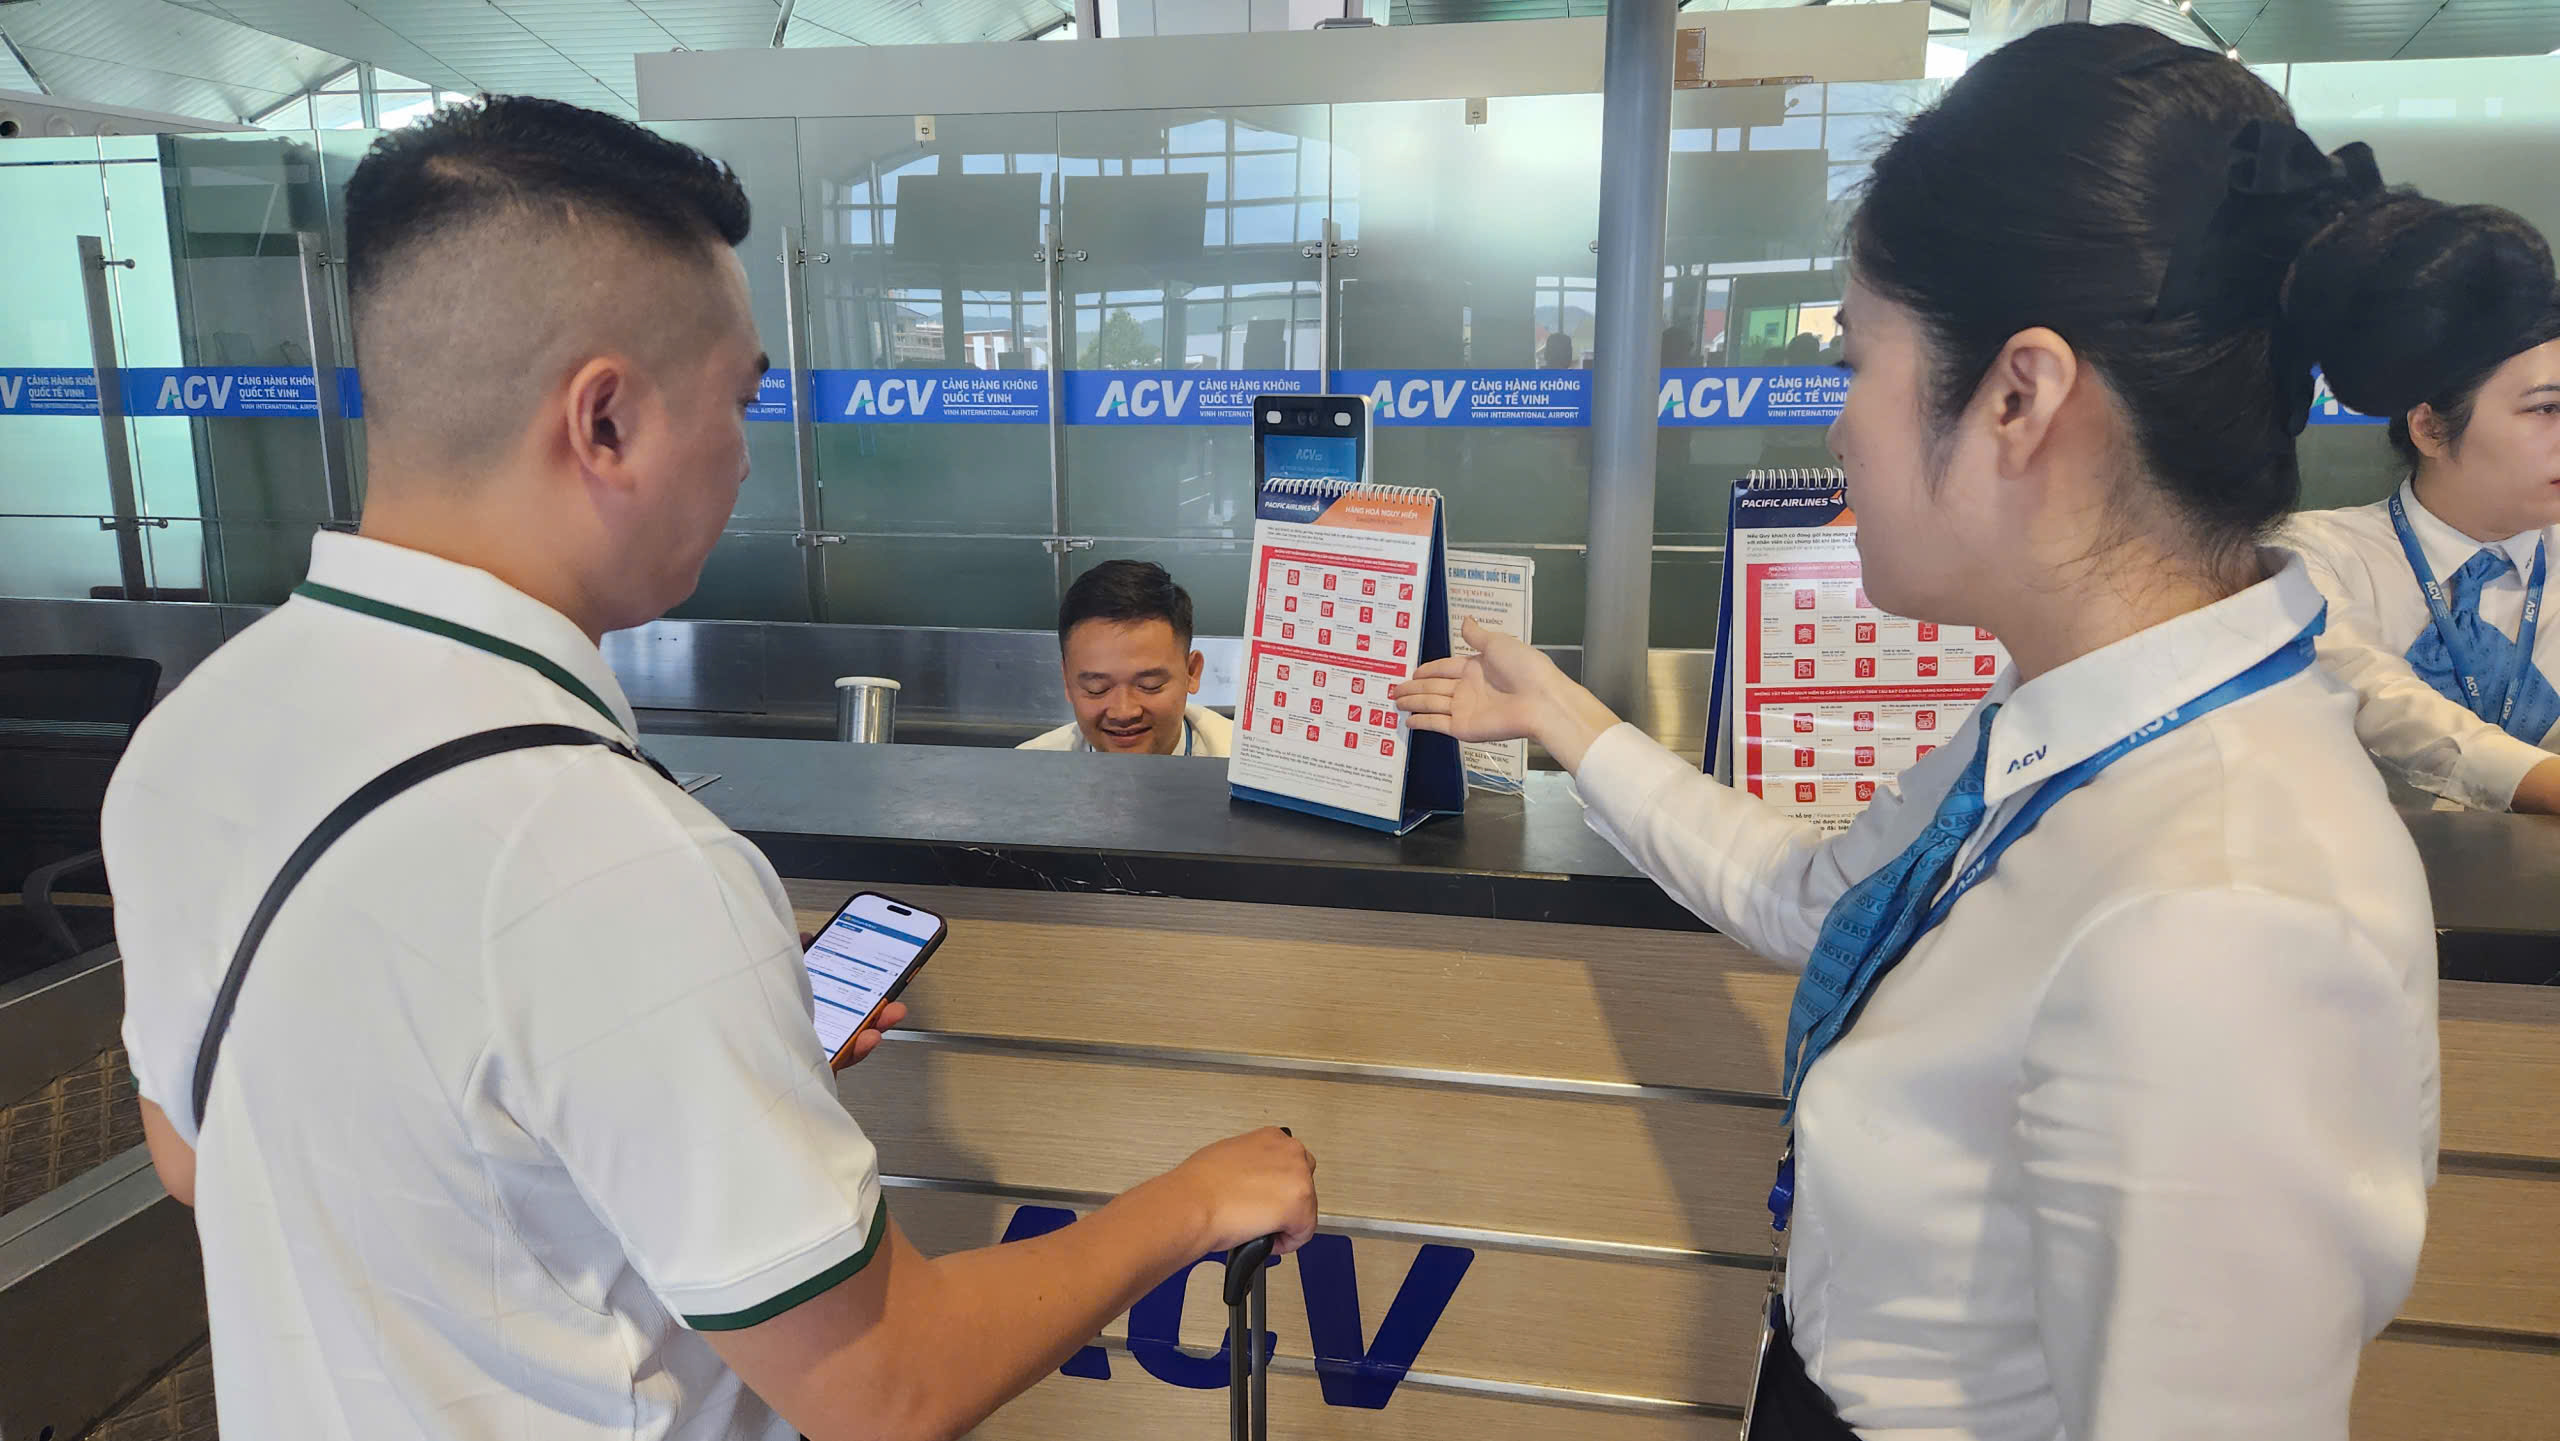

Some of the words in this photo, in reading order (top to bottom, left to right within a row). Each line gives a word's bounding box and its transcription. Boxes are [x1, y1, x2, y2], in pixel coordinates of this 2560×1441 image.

[76, 375, 97, 386] KHÔN
[263, 374, 288, 386] HÀNG
[290, 375, 315, 386] KHÔN
[760, 376, 786, 388] HÔNG
[942, 377, 969, 390] CẢNG
[972, 378, 1000, 390] HÀNG
[1003, 378, 1038, 390] KHÔNG
[1199, 377, 1227, 390] CẢNG
[1230, 378, 1260, 391] HÀNG
[1263, 378, 1300, 391] KHÔNG
[1472, 378, 1502, 390] CẢNG
[1505, 378, 1537, 390] HÀNG
[1540, 378, 1580, 391] KHÔNG
[1768, 375, 1802, 388] CẢNG
[1805, 375, 1840, 388] HÀNG
[64, 388, 85, 397] VINH
[156, 376, 233, 409] ACV
[240, 386, 263, 399] QUỐC
[264, 386, 276, 398] TẾ
[277, 388, 300, 398] VINH
[844, 379, 937, 416] ACV
[943, 390, 970, 404] QUỐC
[972, 390, 984, 403] TẾ
[986, 393, 1012, 403] VINH
[1096, 380, 1194, 418] ACV
[1200, 391, 1228, 405] QUỐC
[1230, 391, 1243, 404] TẾ
[1369, 380, 1466, 418] ACV
[1472, 391, 1502, 406] QUỐC
[1504, 391, 1519, 405] TẾ
[1521, 394, 1550, 405] VINH
[1658, 378, 1763, 418] ACV
[1768, 388, 1801, 405] QUỐC
[1804, 388, 1820, 402] TẾ
[1742, 499, 1780, 508] PACIFIC
[1781, 498, 1828, 507] AIRLINES
[2425, 581, 2441, 600] ACV
[2524, 600, 2536, 622] ACV
[2465, 676, 2480, 697] ACV
[2502, 698, 2513, 720] ACV
[2006, 744, 2047, 774] ACV
